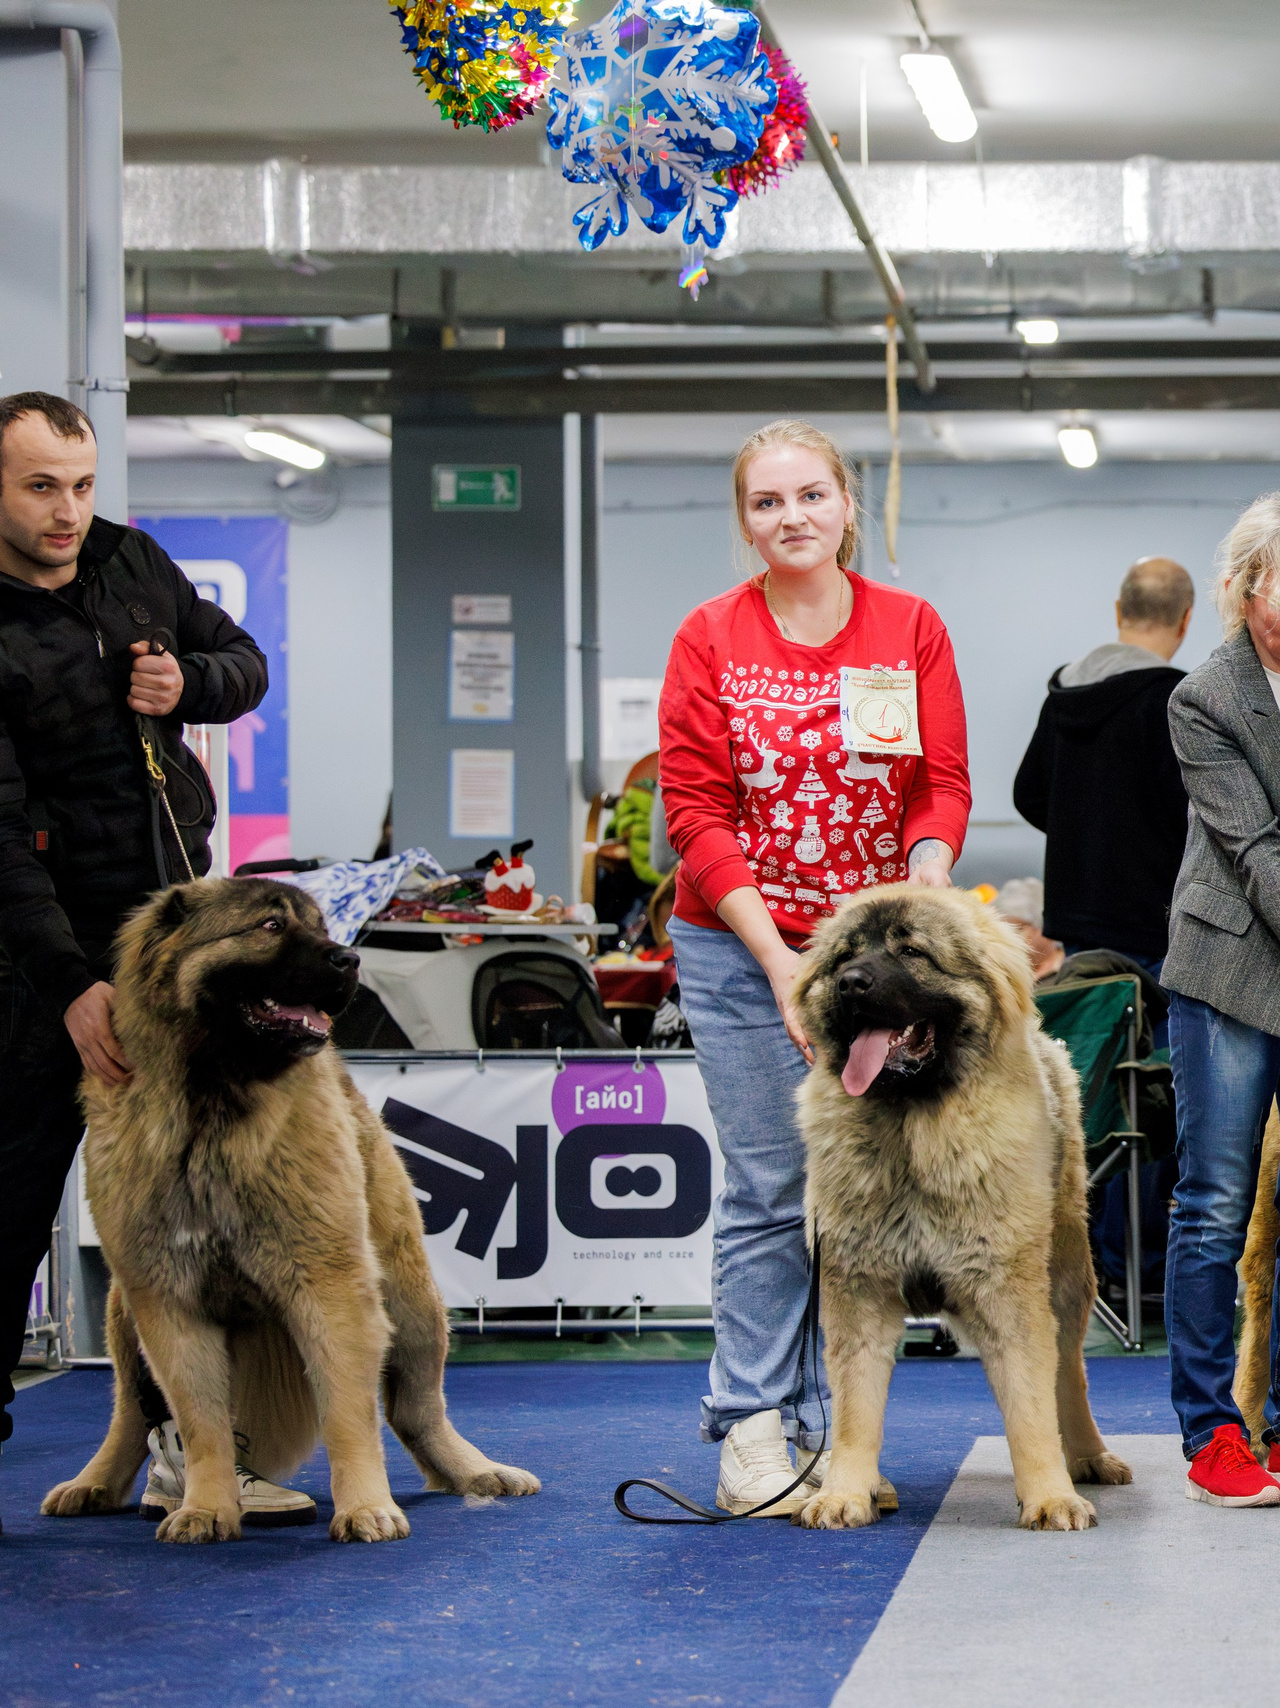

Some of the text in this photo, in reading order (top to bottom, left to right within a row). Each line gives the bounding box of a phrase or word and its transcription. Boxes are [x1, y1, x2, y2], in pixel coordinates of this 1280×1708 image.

[876, 703, 888, 728] 1
[572, 1249, 694, 1261] technology and care
